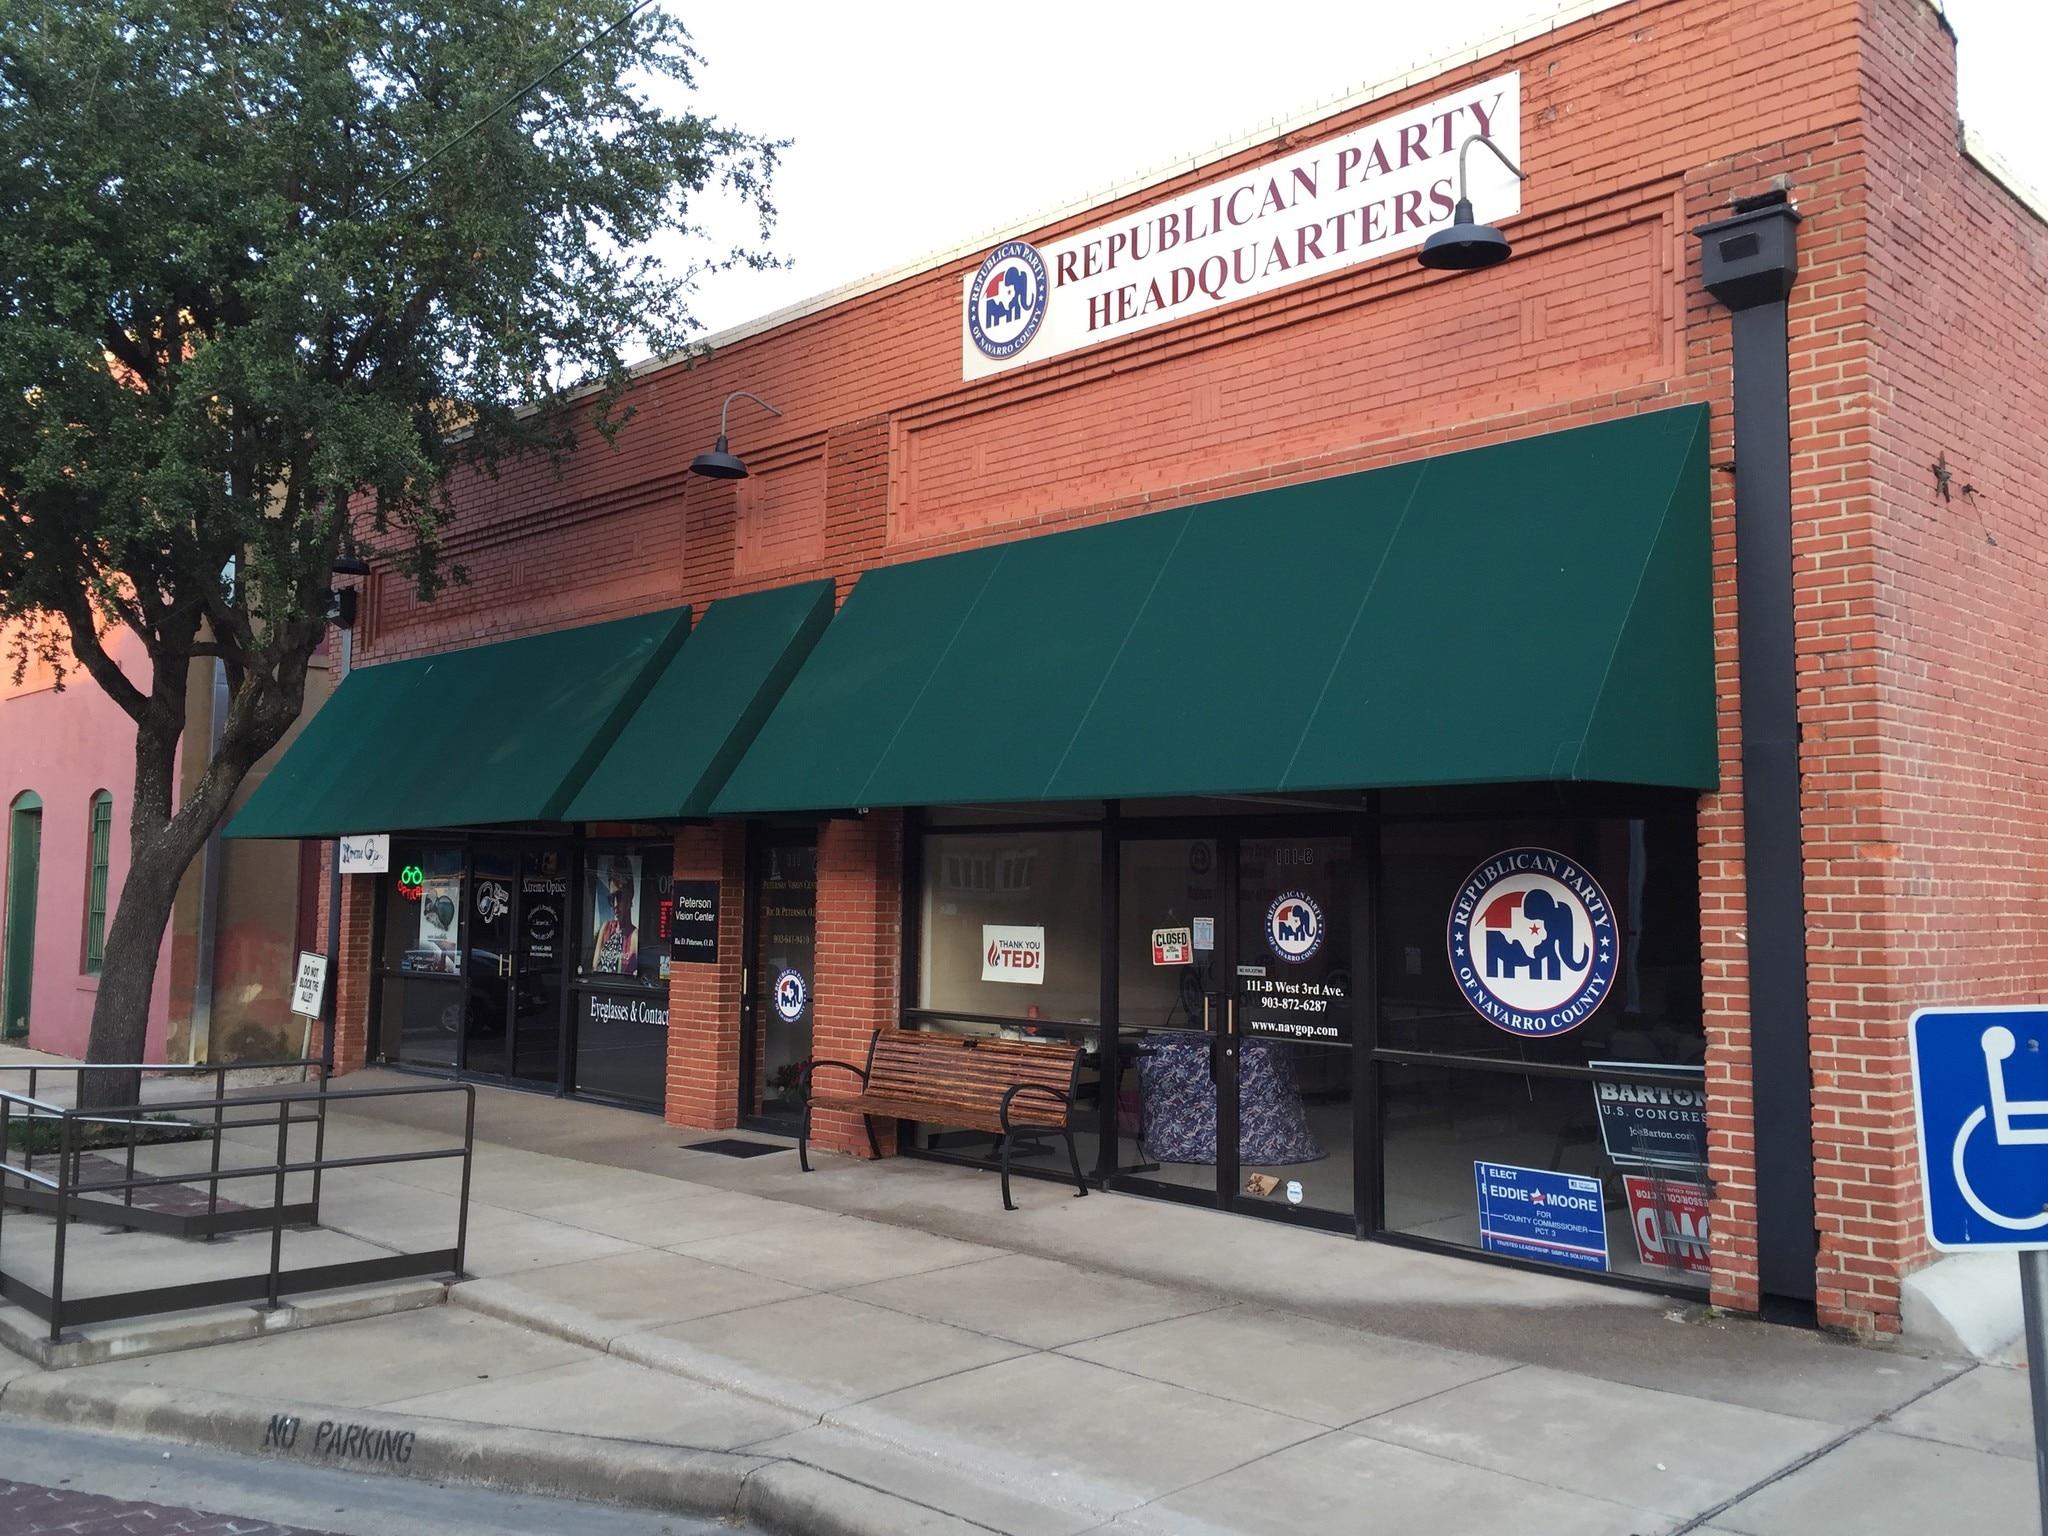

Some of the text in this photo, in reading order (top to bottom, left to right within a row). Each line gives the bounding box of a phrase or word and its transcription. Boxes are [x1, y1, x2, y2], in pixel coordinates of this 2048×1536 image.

[1054, 91, 1506, 289] REPUBLICAN PARTY
[1086, 177, 1455, 333] HEADQUARTERS
[971, 245, 1045, 301] REPUBLICAN PARTY
[972, 308, 1042, 356] OF NAVARRO COUNTY
[1276, 848, 1314, 865] 111-B
[522, 879, 567, 896] Xtreme Optics
[1454, 854, 1611, 930] REPUBLICAN PARTY
[679, 896, 712, 909] Peterson
[1267, 890, 1322, 920] REPUBLICAN PARTY
[675, 910, 715, 922] Vision Center
[999, 940, 1041, 950] THANK YOU
[1156, 932, 1187, 947] CLOSED
[1274, 945, 1301, 962] NAVARRO
[1301, 938, 1321, 960] COUNTY
[1001, 950, 1040, 969] TED!
[303, 964, 320, 978] DO NOT
[299, 977, 320, 992] BLOCK THE
[1246, 980, 1344, 997] 111-B West 3rd Ave.
[301, 991, 314, 1003] ALLEY
[1261, 997, 1327, 1012] 903-872-6287
[1459, 966, 1608, 1032] OF NAVARRO COUNTY
[590, 996, 629, 1023] Eyeglasses
[630, 1000, 637, 1022] &
[1251, 1021, 1338, 1037] www.navgop.com
[1602, 1104, 1629, 1117] U.S.
[1489, 1168, 1517, 1180] ELECT
[1490, 1184, 1598, 1212] EDDIE MOORE
[1536, 1210, 1552, 1219] FOR
[1503, 1213, 1588, 1234] COUNTY COMMISSIONER
[1496, 1240, 1518, 1250] TRUSTED
[1551, 1249, 1569, 1258] SIMPLE
[264, 1414, 416, 1463] NO PARKING
